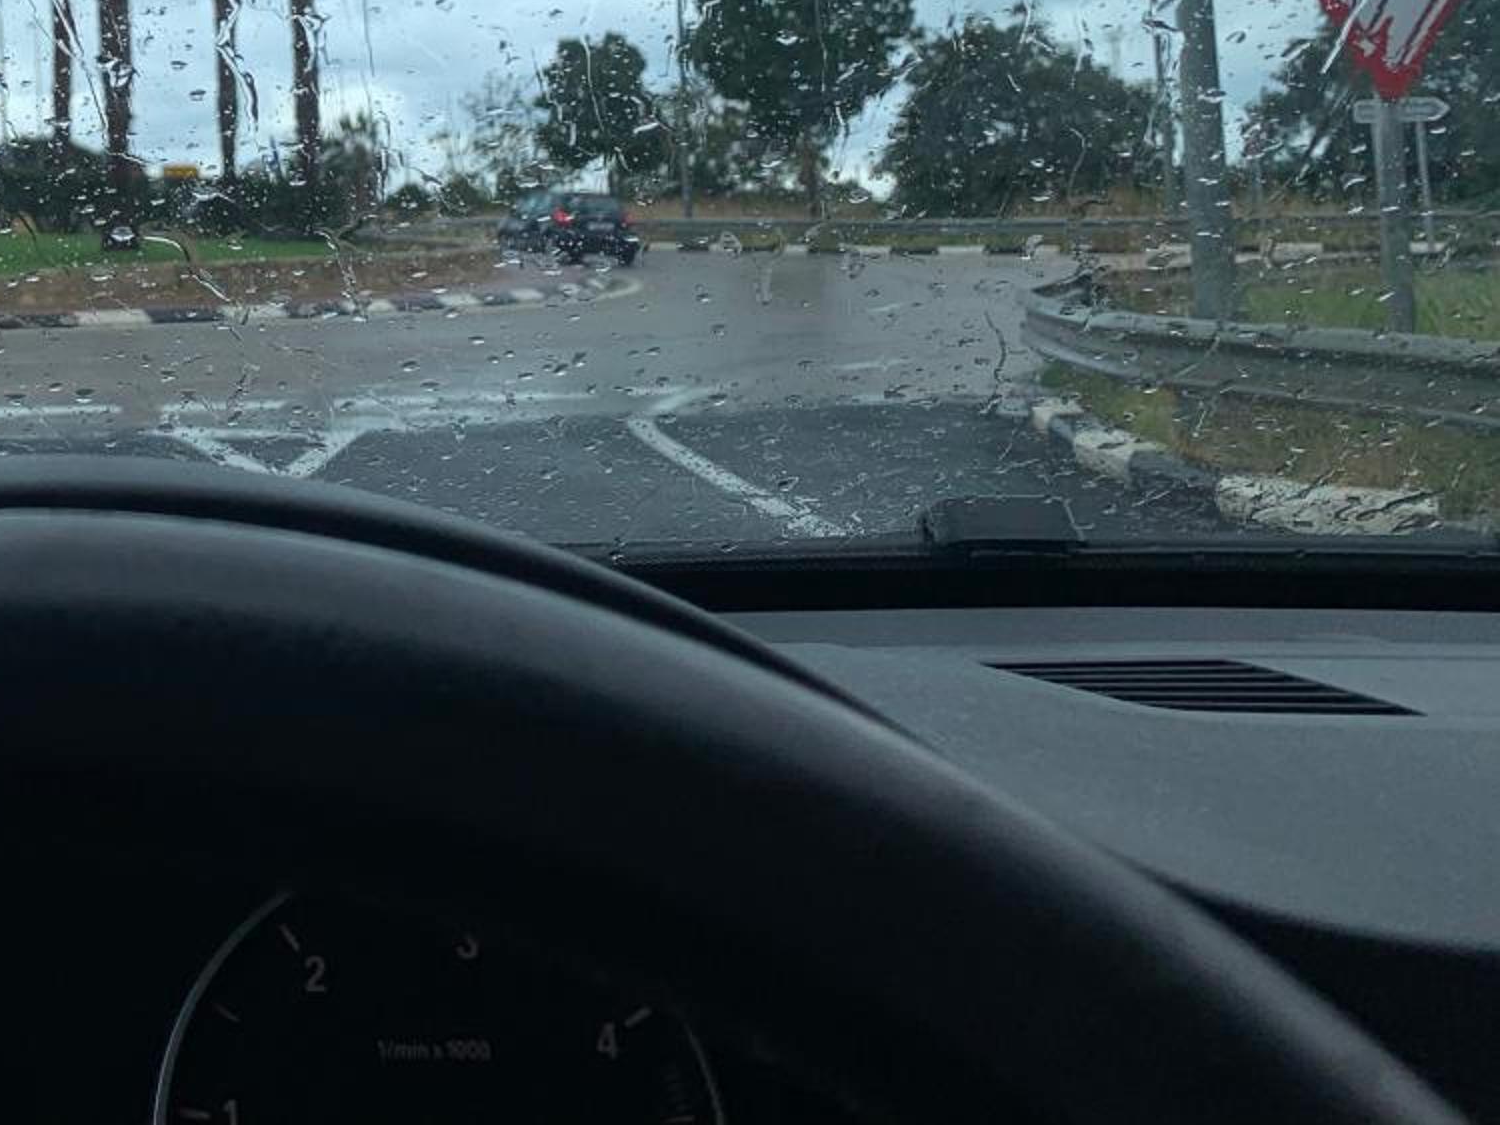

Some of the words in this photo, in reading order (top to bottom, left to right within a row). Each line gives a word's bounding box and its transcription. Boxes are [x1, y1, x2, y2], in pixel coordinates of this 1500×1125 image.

[304, 956, 326, 993] 2
[596, 1022, 621, 1060] 4
[222, 1098, 239, 1125] 1
